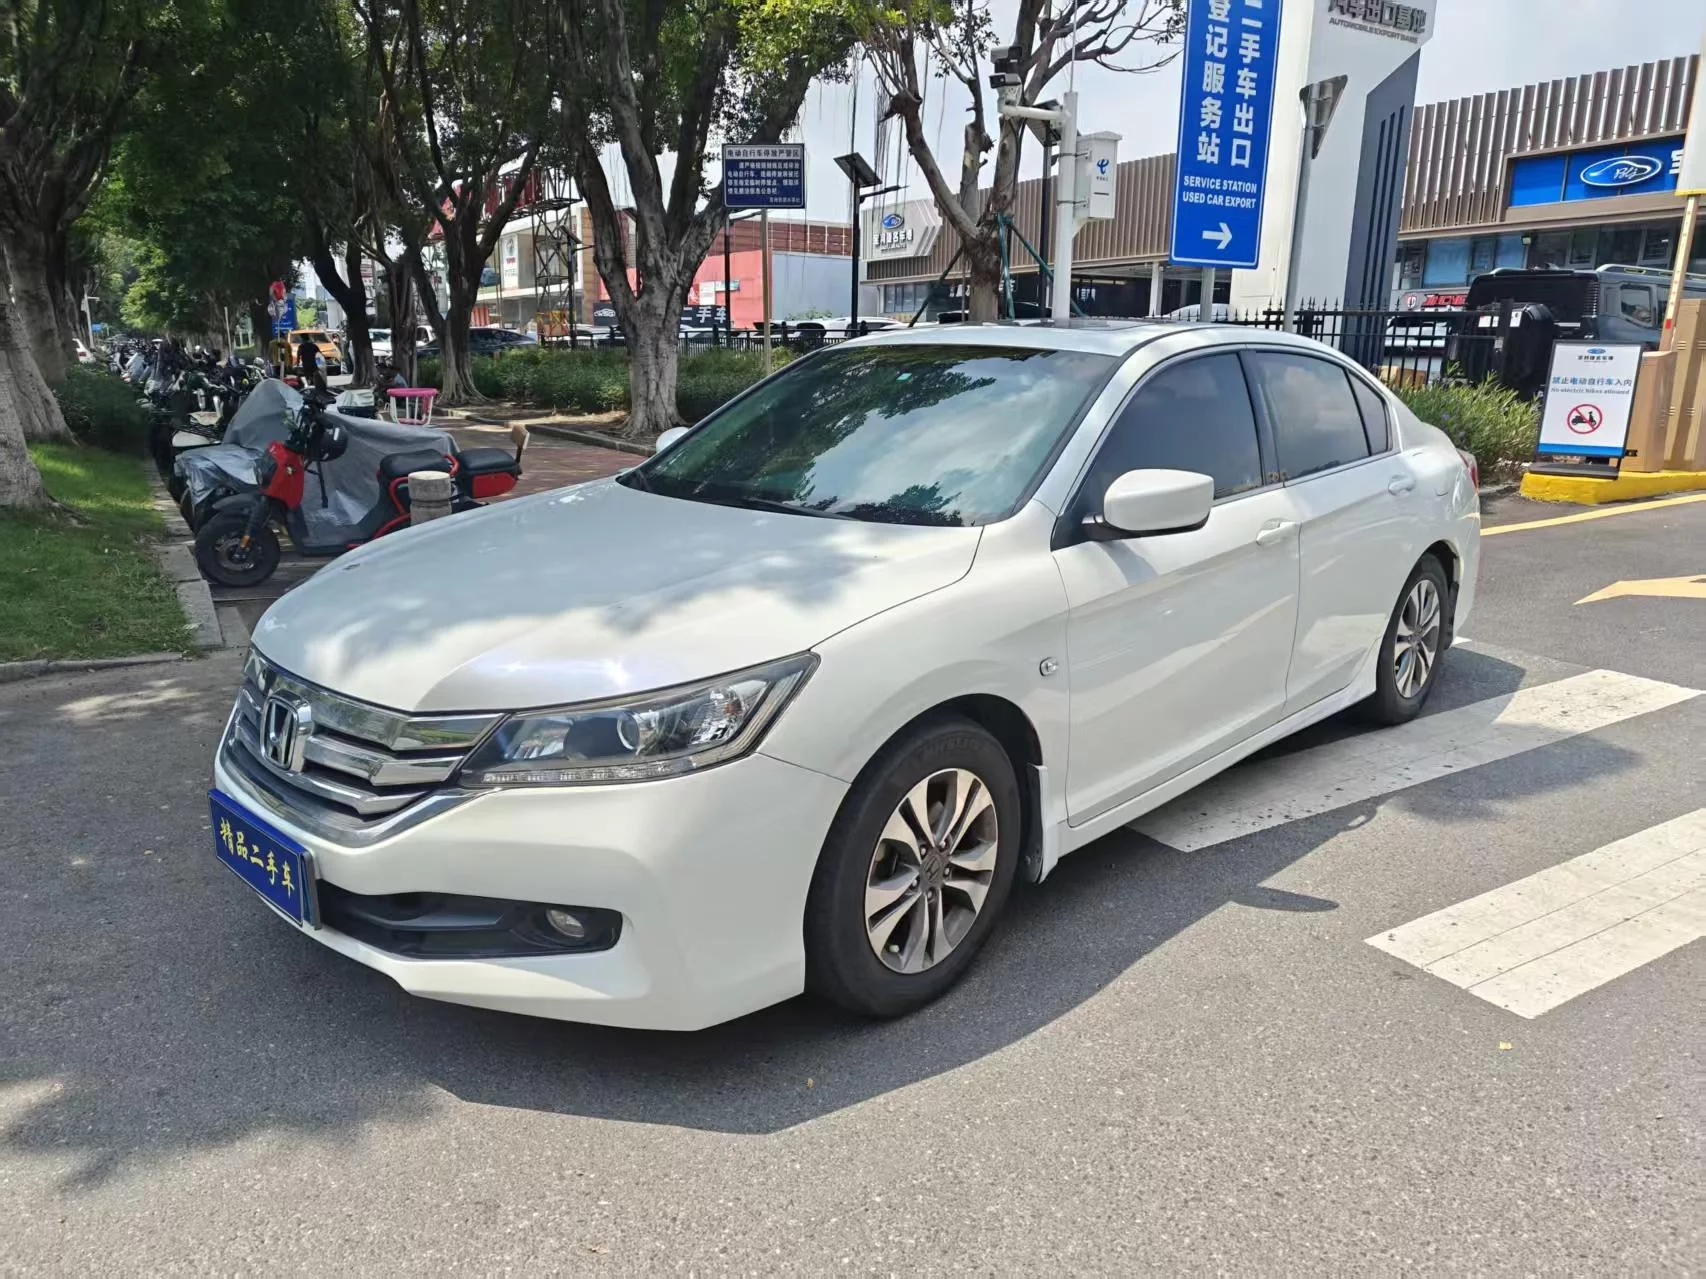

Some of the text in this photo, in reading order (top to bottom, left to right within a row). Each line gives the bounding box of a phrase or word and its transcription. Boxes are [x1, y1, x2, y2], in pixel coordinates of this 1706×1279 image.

[1374, 27, 1400, 40] EXPORT
[1197, 0, 1231, 165] 登记服务站
[1231, 0, 1263, 168] 二手车出口
[1183, 175, 1258, 194] SERVICE STATION
[1182, 191, 1257, 209] USED CAR EXPORT
[681, 306, 727, 324] 二手车
[220, 816, 296, 899] 精品二手车
